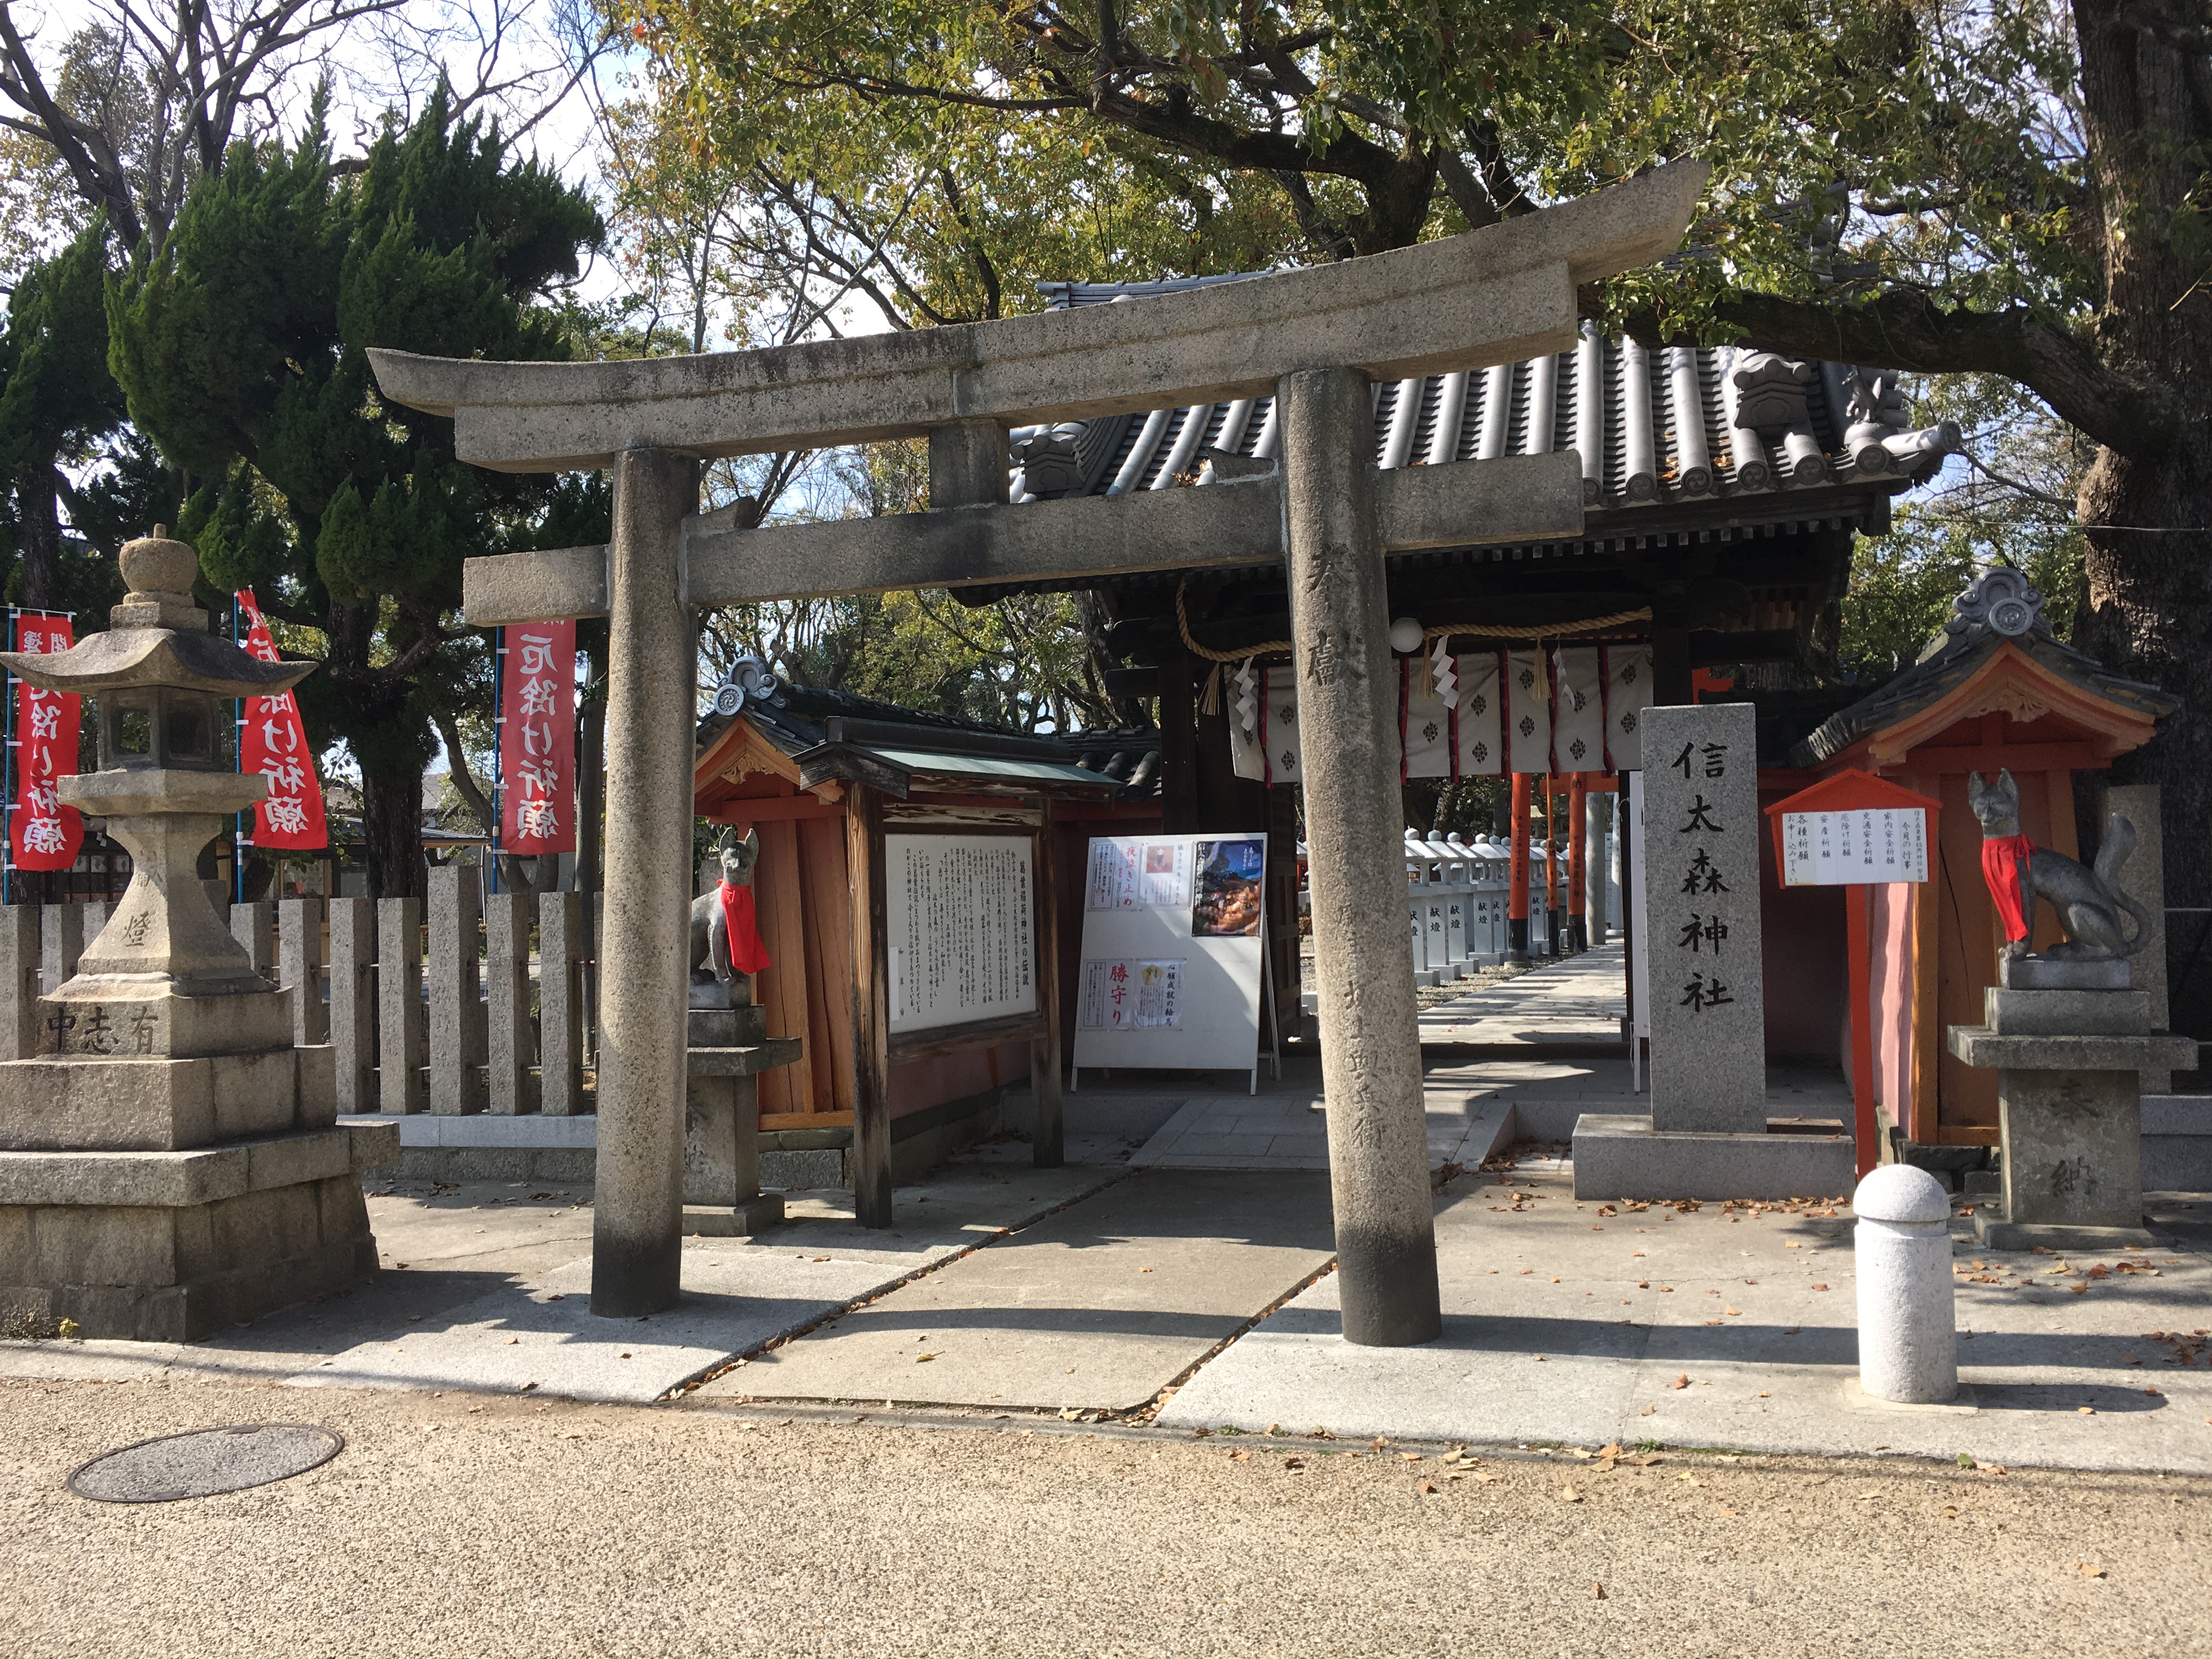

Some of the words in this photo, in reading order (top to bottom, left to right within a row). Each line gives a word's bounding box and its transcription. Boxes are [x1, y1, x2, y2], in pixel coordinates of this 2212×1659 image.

[1797, 815, 1809, 861] 各種祈願
[1820, 814, 1831, 859] 安産祈願
[1841, 813, 1852, 857] 厄除け祈願
[1863, 812, 1874, 865] 交通安全祈願
[1884, 812, 1895, 865] 家内安全祈願
[1901, 822, 1912, 870] 今月の行事
[1123, 845, 1137, 906] 夜泣き止め
[1174, 844, 1184, 905] 張り子のキツネさん
[1672, 742, 1734, 1013] 信太森神社
[1430, 906, 1441, 933] 献燈
[1450, 905, 1462, 929] 献燈
[1478, 901, 1488, 925] 献燈
[1109, 963, 1130, 1025] 勝守り
[1165, 964, 1176, 1027] 心願成就の絵馬
